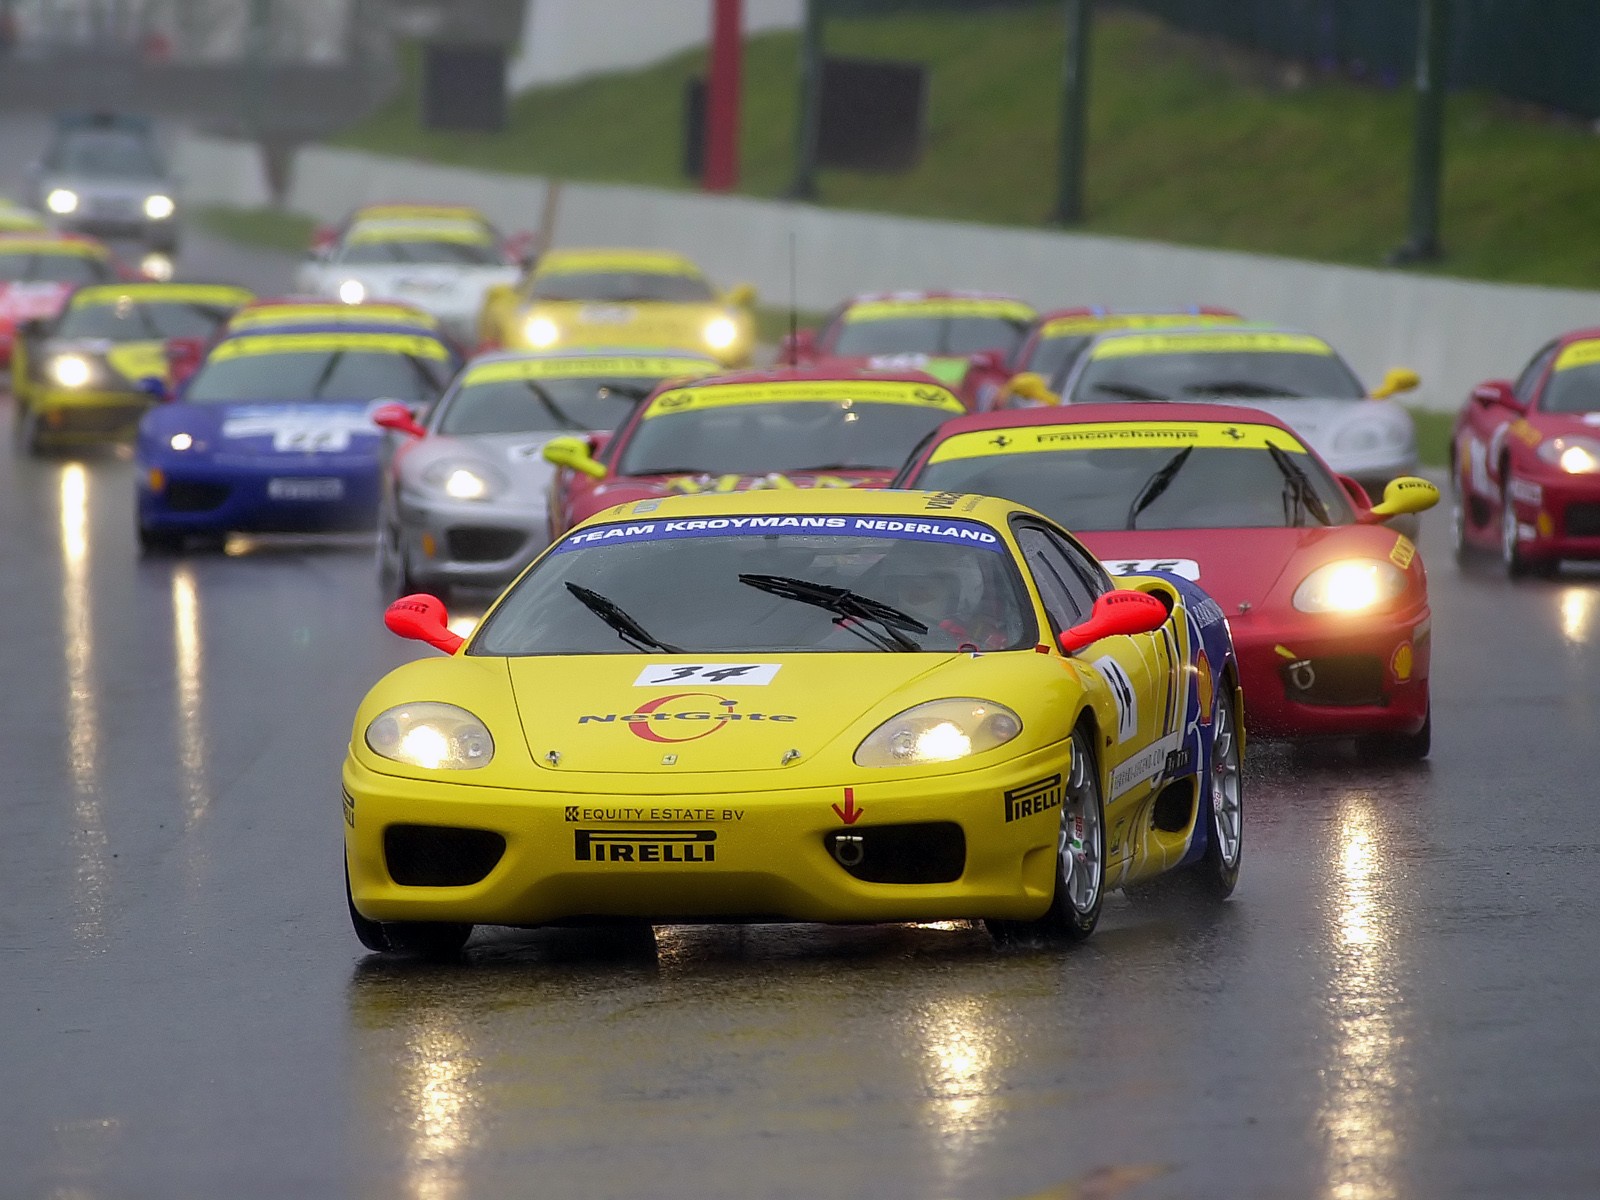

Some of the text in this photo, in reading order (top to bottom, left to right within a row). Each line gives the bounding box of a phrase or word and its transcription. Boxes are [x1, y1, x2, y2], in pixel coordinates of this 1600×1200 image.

[1037, 430, 1199, 443] Francorchamps
[570, 517, 997, 544] TEAM KROYMANS NEDERLAND
[650, 666, 760, 683] 34
[577, 711, 799, 725] NetGate
[1004, 772, 1061, 823] PIRELLI
[583, 808, 745, 820] EQUITY ESTATE BV
[574, 829, 718, 861] PIRELLI
